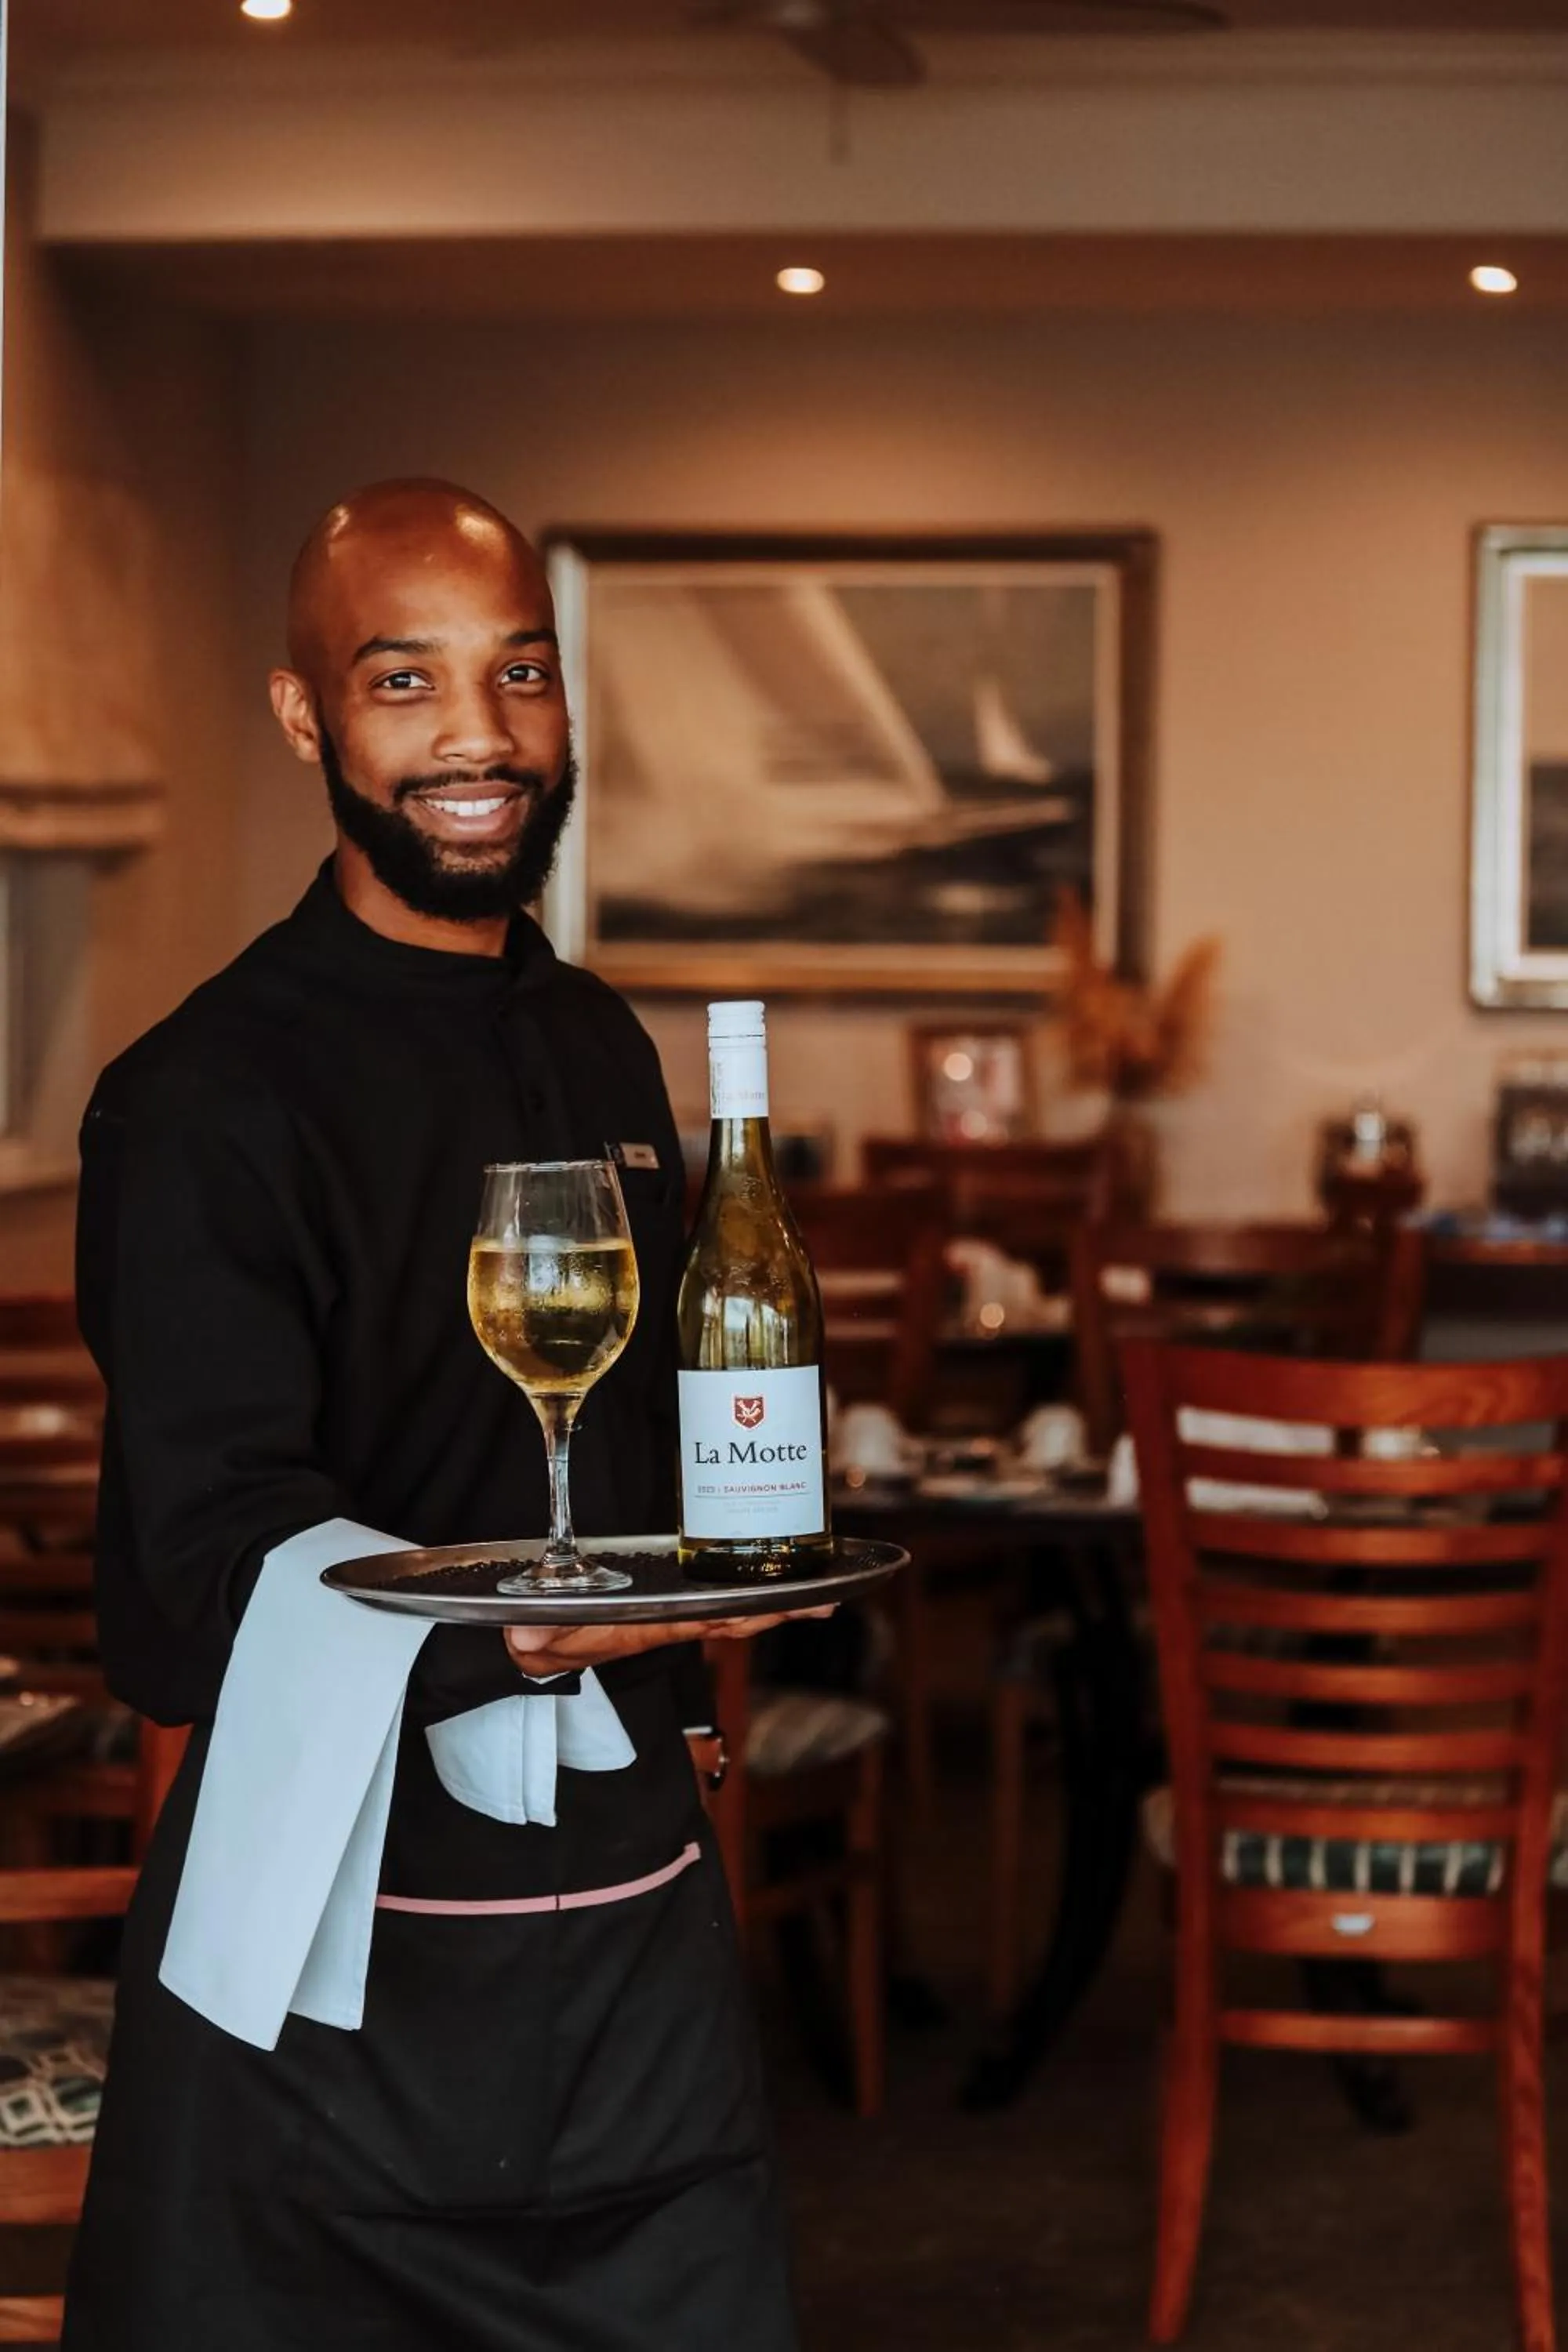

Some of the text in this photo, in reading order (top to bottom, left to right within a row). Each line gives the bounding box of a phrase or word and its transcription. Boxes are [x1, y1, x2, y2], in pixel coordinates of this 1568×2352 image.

[695, 1441, 807, 1464] La Motte
[724, 1483, 777, 1494] SAUVIGNON
[779, 1481, 807, 1490] BLANC
